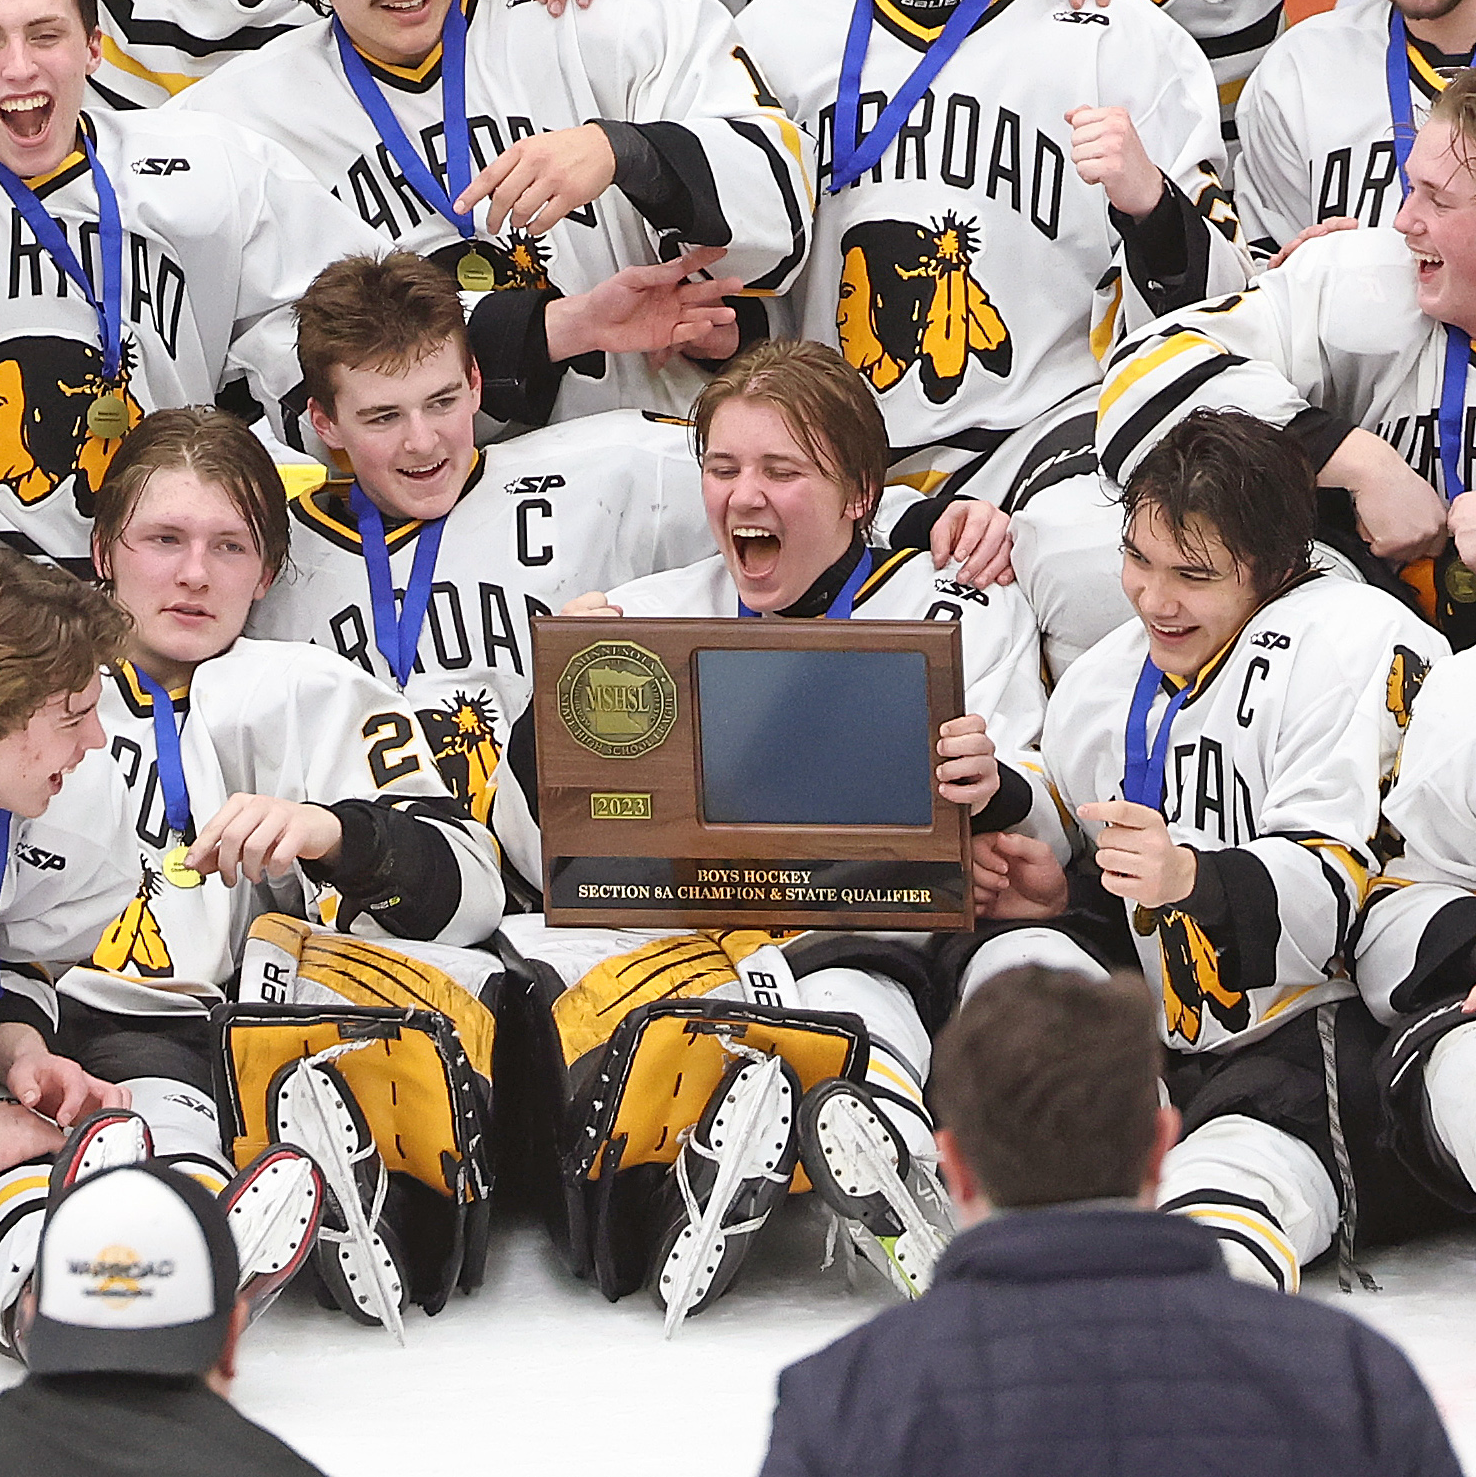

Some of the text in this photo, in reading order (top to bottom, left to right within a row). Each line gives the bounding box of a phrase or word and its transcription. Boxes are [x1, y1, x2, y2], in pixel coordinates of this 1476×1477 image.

[139, 158, 191, 185] SP
[810, 88, 1065, 241] ARROAD
[514, 464, 566, 494] SP
[517, 499, 552, 567] C
[585, 684, 650, 713] MSHSL
[1237, 656, 1270, 727] C
[596, 798, 646, 817] 2023
[698, 869, 812, 885] BOYS HOCKEY
[578, 883, 932, 904] SECTION 8A CHAMPION & STATE QUALIFIER
